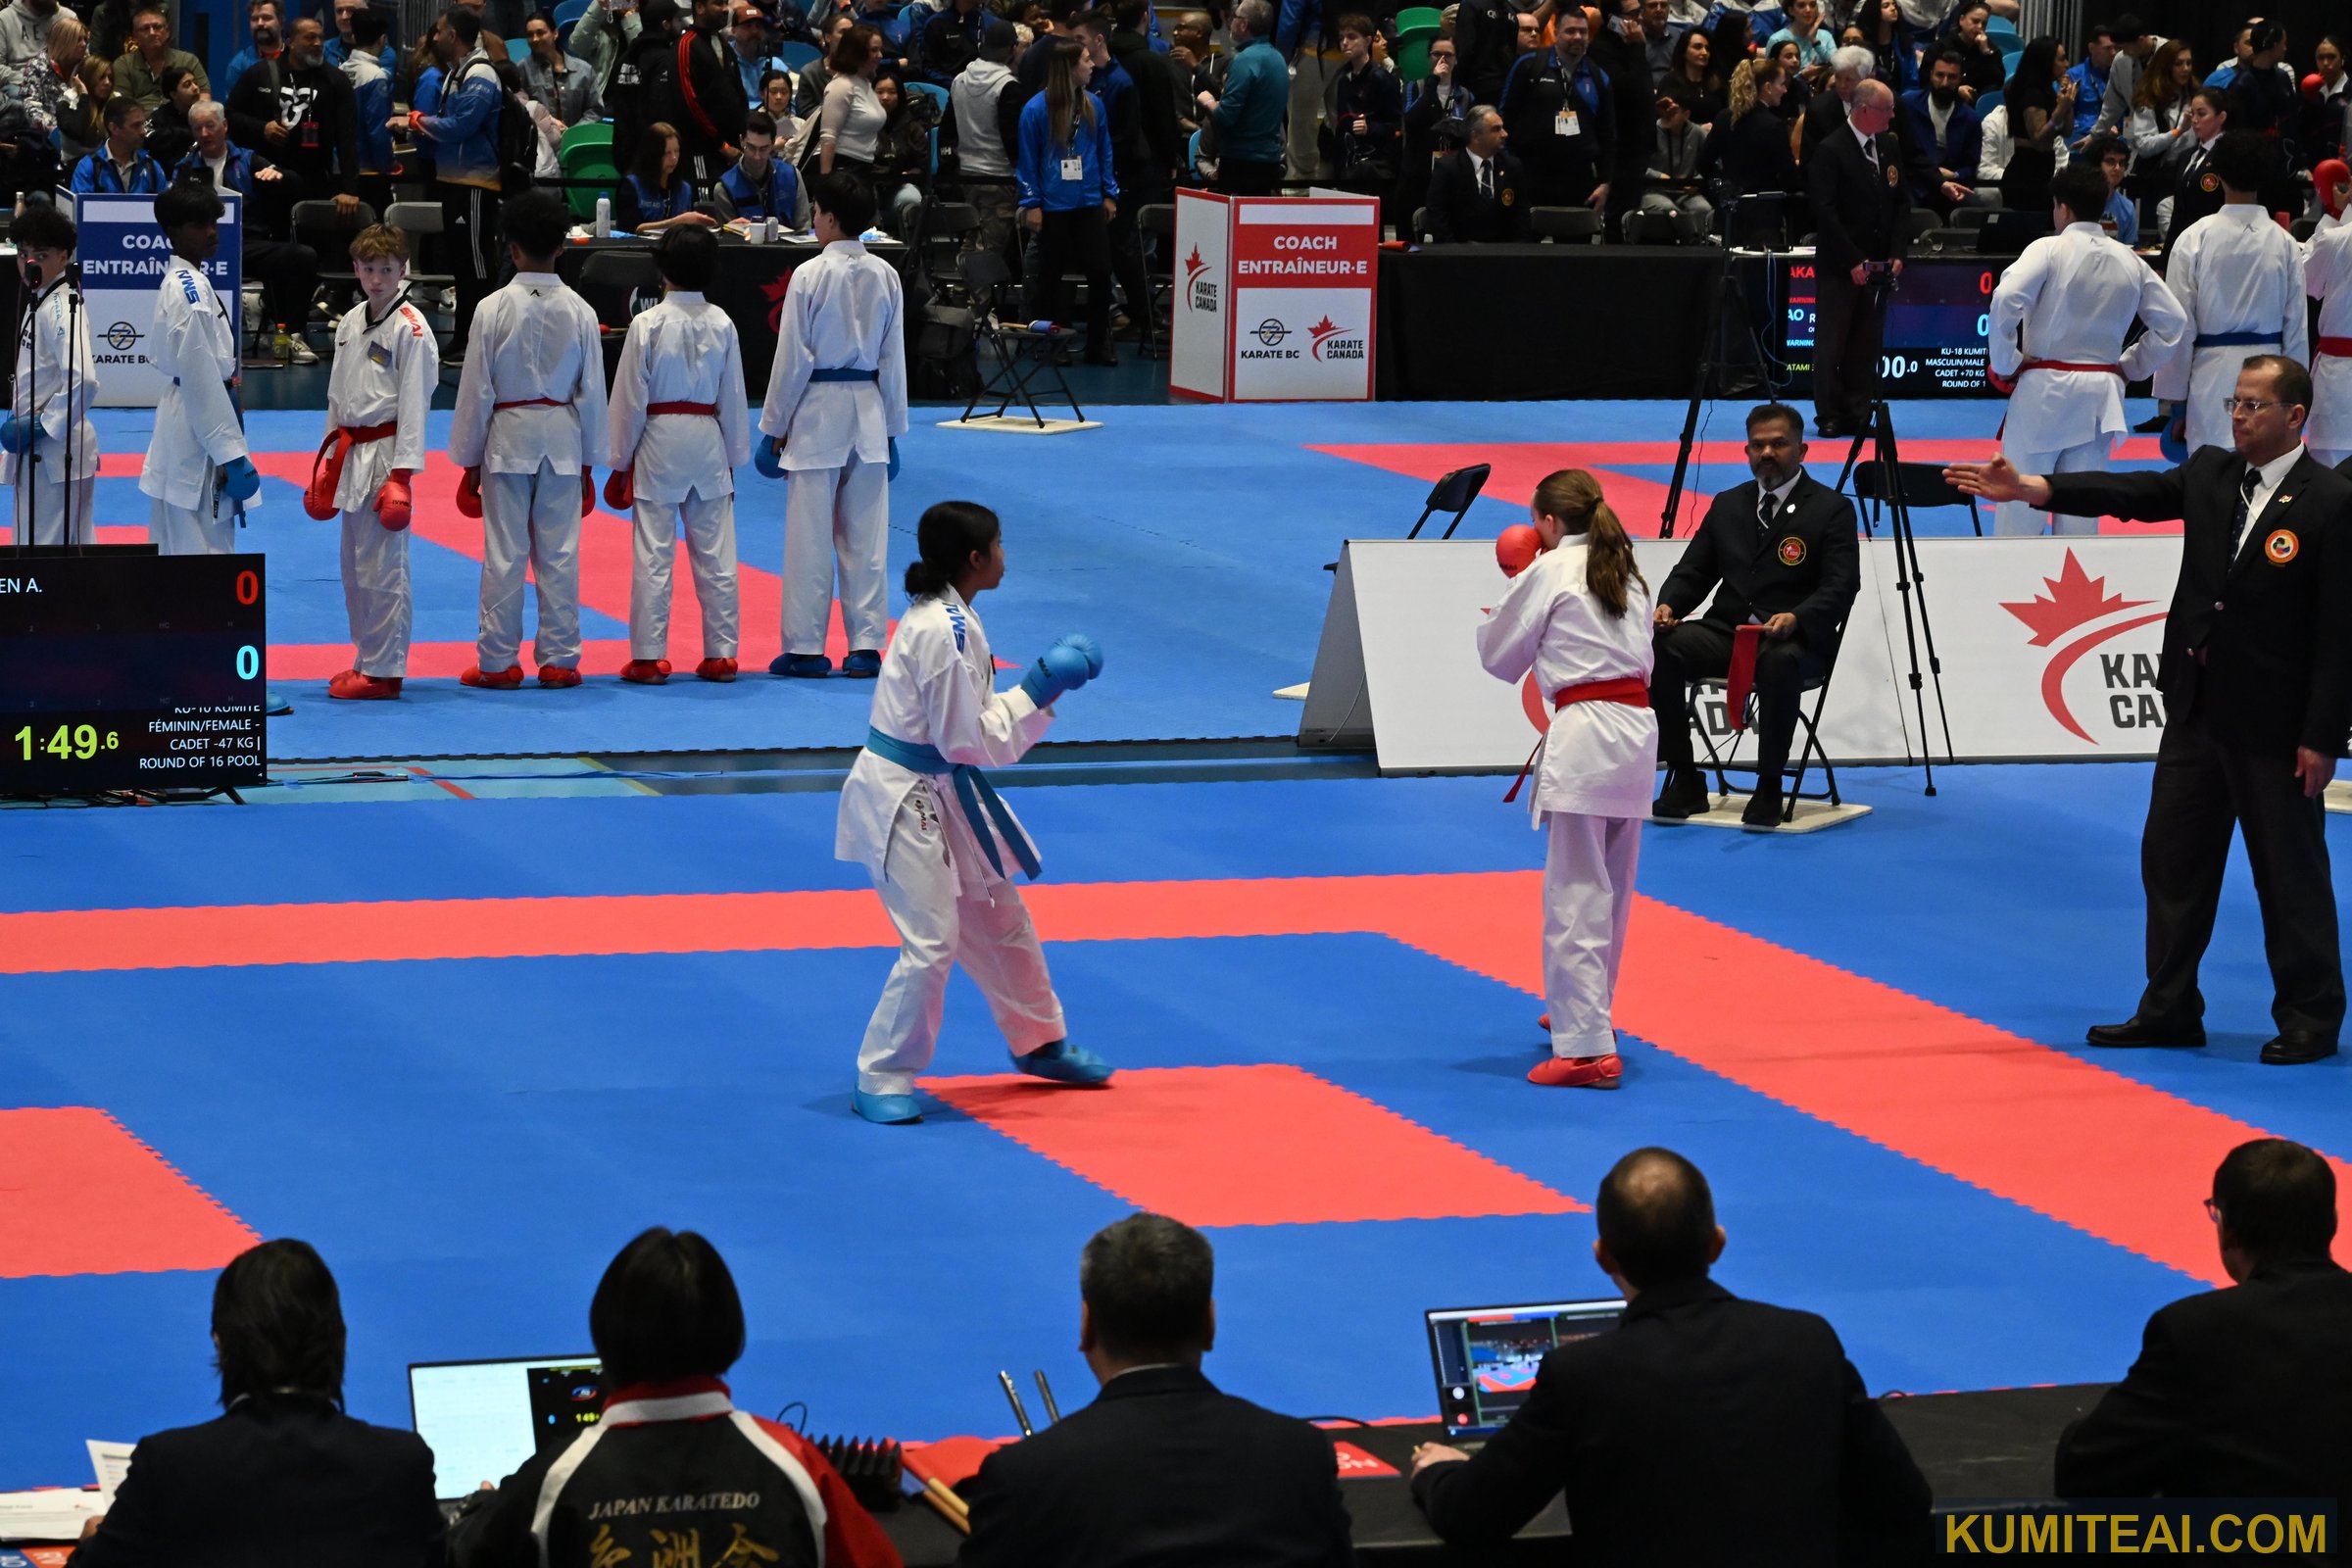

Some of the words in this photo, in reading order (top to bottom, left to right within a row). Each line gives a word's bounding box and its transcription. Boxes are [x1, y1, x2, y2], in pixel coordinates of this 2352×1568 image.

[122, 235, 173, 249] COA
[1273, 236, 1338, 250] COACH
[83, 257, 227, 275] ENTRAÎNR·E
[1196, 281, 1217, 297] KARATE
[1980, 271, 1992, 294] 0
[1195, 296, 1217, 313] CANADA
[399, 307, 423, 337] SMAI
[1977, 314, 1989, 336] 0
[1327, 340, 1363, 349] KARATE
[1241, 350, 1283, 359] KARATE
[1286, 350, 1299, 359] BC
[1327, 350, 1364, 359] CANADA
[25, 577, 42, 593] A.
[235, 569, 259, 605] 0
[236, 645, 259, 680] 0
[2100, 654, 2162, 688] KA
[2110, 694, 2164, 728] CA
[149, 718, 252, 732] FÉMININ/FEMALE
[15, 724, 119, 761] 1:49.6
[170, 738, 210, 750] CADET
[214, 738, 233, 749] -47
[237, 737, 253, 749] KG
[139, 757, 186, 769] ROUND
[189, 757, 206, 767] OF
[210, 756, 223, 766] 16
[227, 755, 261, 766] POOL
[588, 1496, 651, 1520] JAPAN
[655, 1492, 760, 1513] KARATEDO
